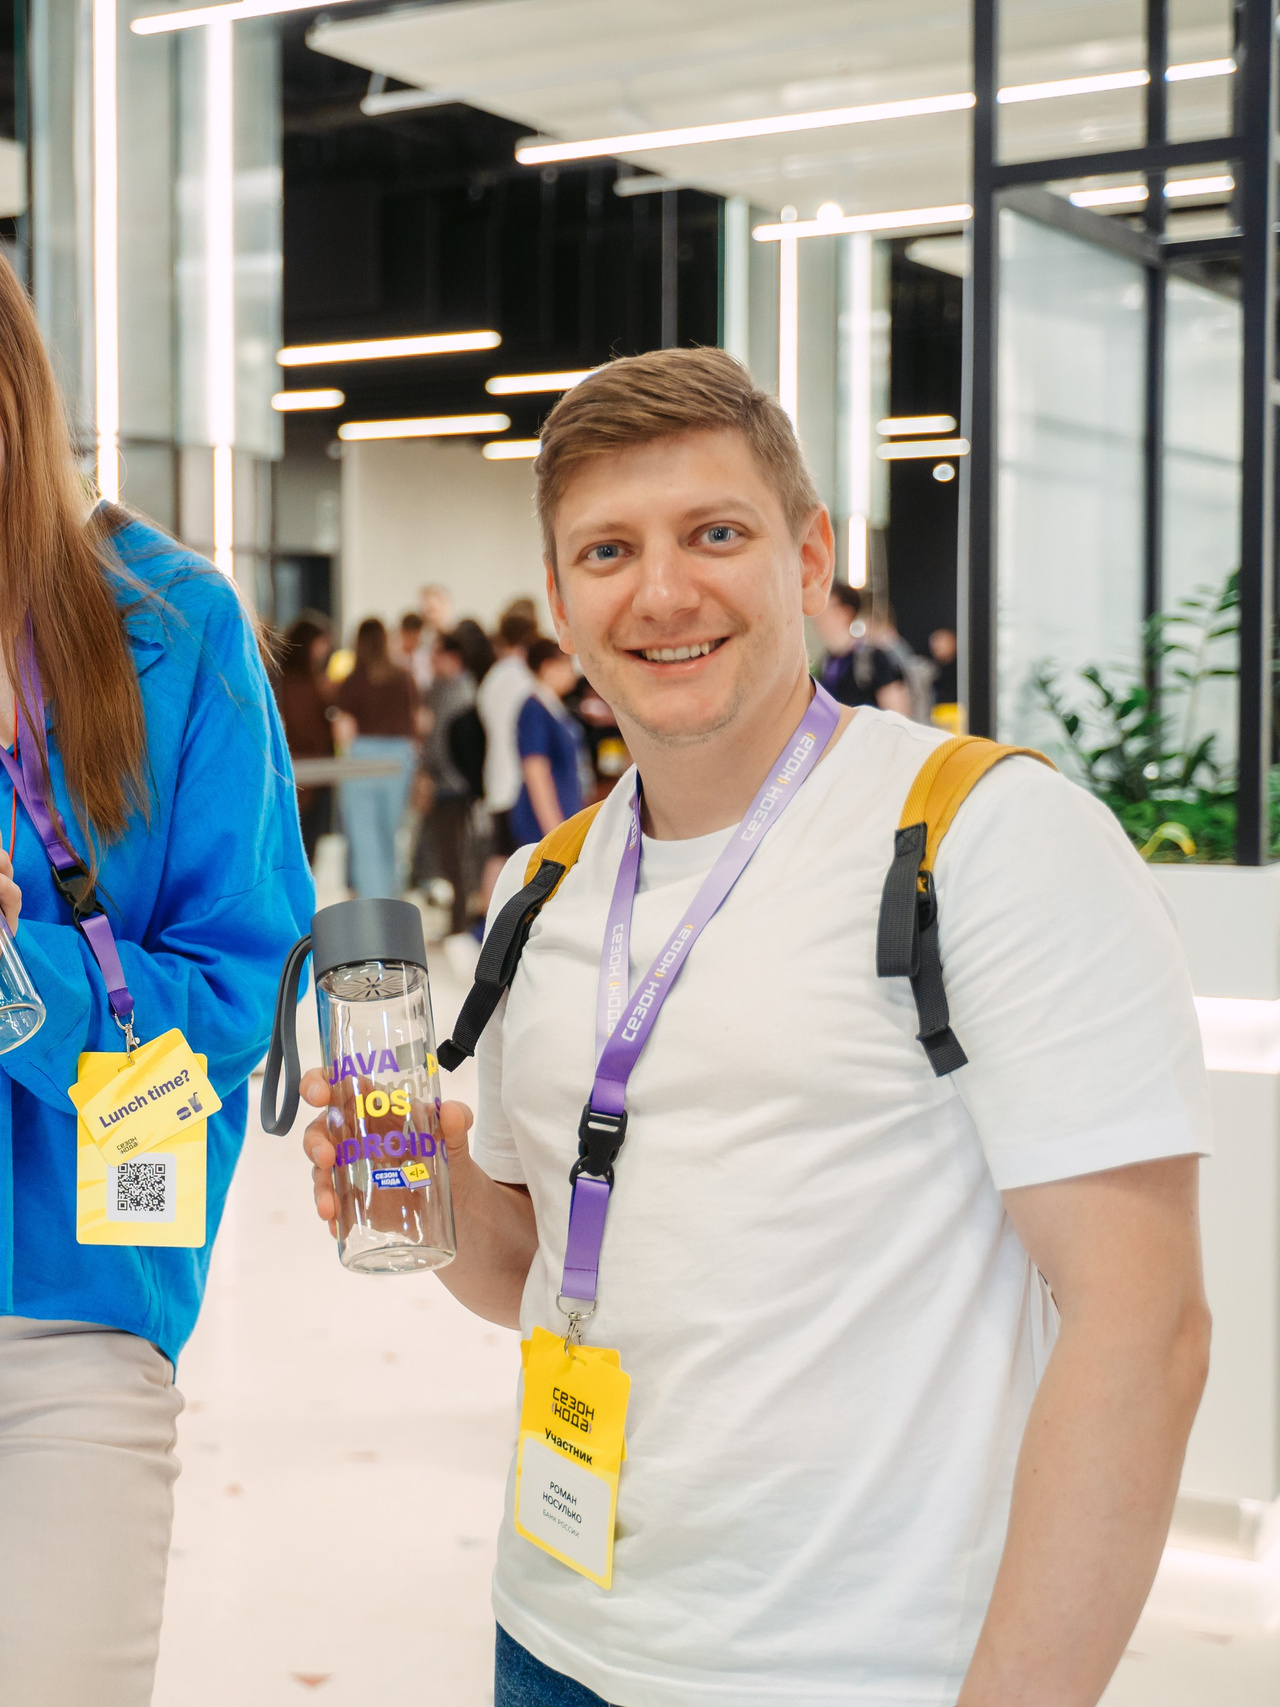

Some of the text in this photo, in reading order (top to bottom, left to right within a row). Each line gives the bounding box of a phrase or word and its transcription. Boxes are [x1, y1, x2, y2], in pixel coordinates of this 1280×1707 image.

[329, 1048, 400, 1085] JAVA
[98, 1069, 191, 1129] Lunch time?
[552, 1386, 595, 1421] сезон
[544, 1427, 593, 1466] Участник
[542, 1491, 582, 1524] НОСУЛЬКО
[549, 1481, 578, 1506] РОМАН
[542, 1508, 580, 1538] БАНК РОССИИ
